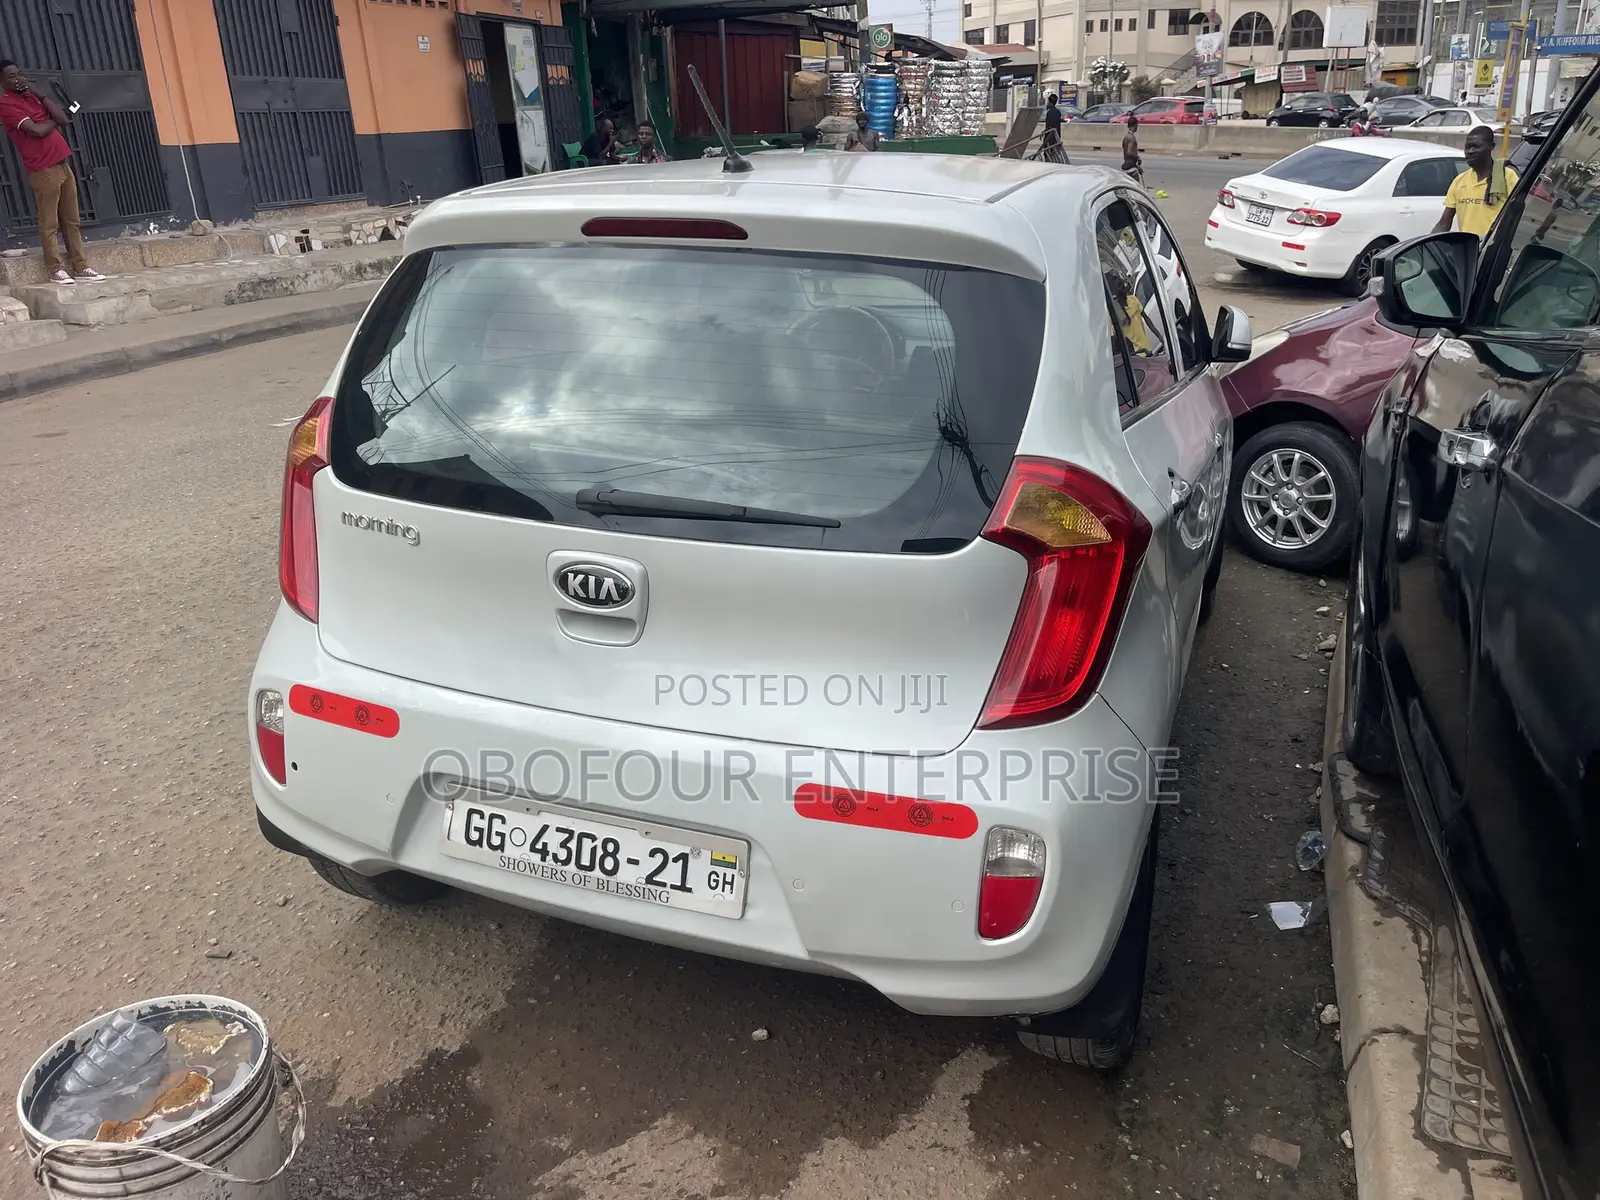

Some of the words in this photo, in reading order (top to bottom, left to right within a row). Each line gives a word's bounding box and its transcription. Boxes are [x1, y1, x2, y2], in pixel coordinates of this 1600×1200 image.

[875, 33, 888, 43] glo
[341, 510, 421, 546] morning
[566, 572, 622, 601] KIA
[464, 807, 507, 854] GG
[529, 823, 694, 894] 4308-21
[499, 855, 567, 883] SHOWERS
[571, 873, 592, 887] OF
[595, 877, 670, 904] BLESSING
[707, 870, 735, 894] GH
